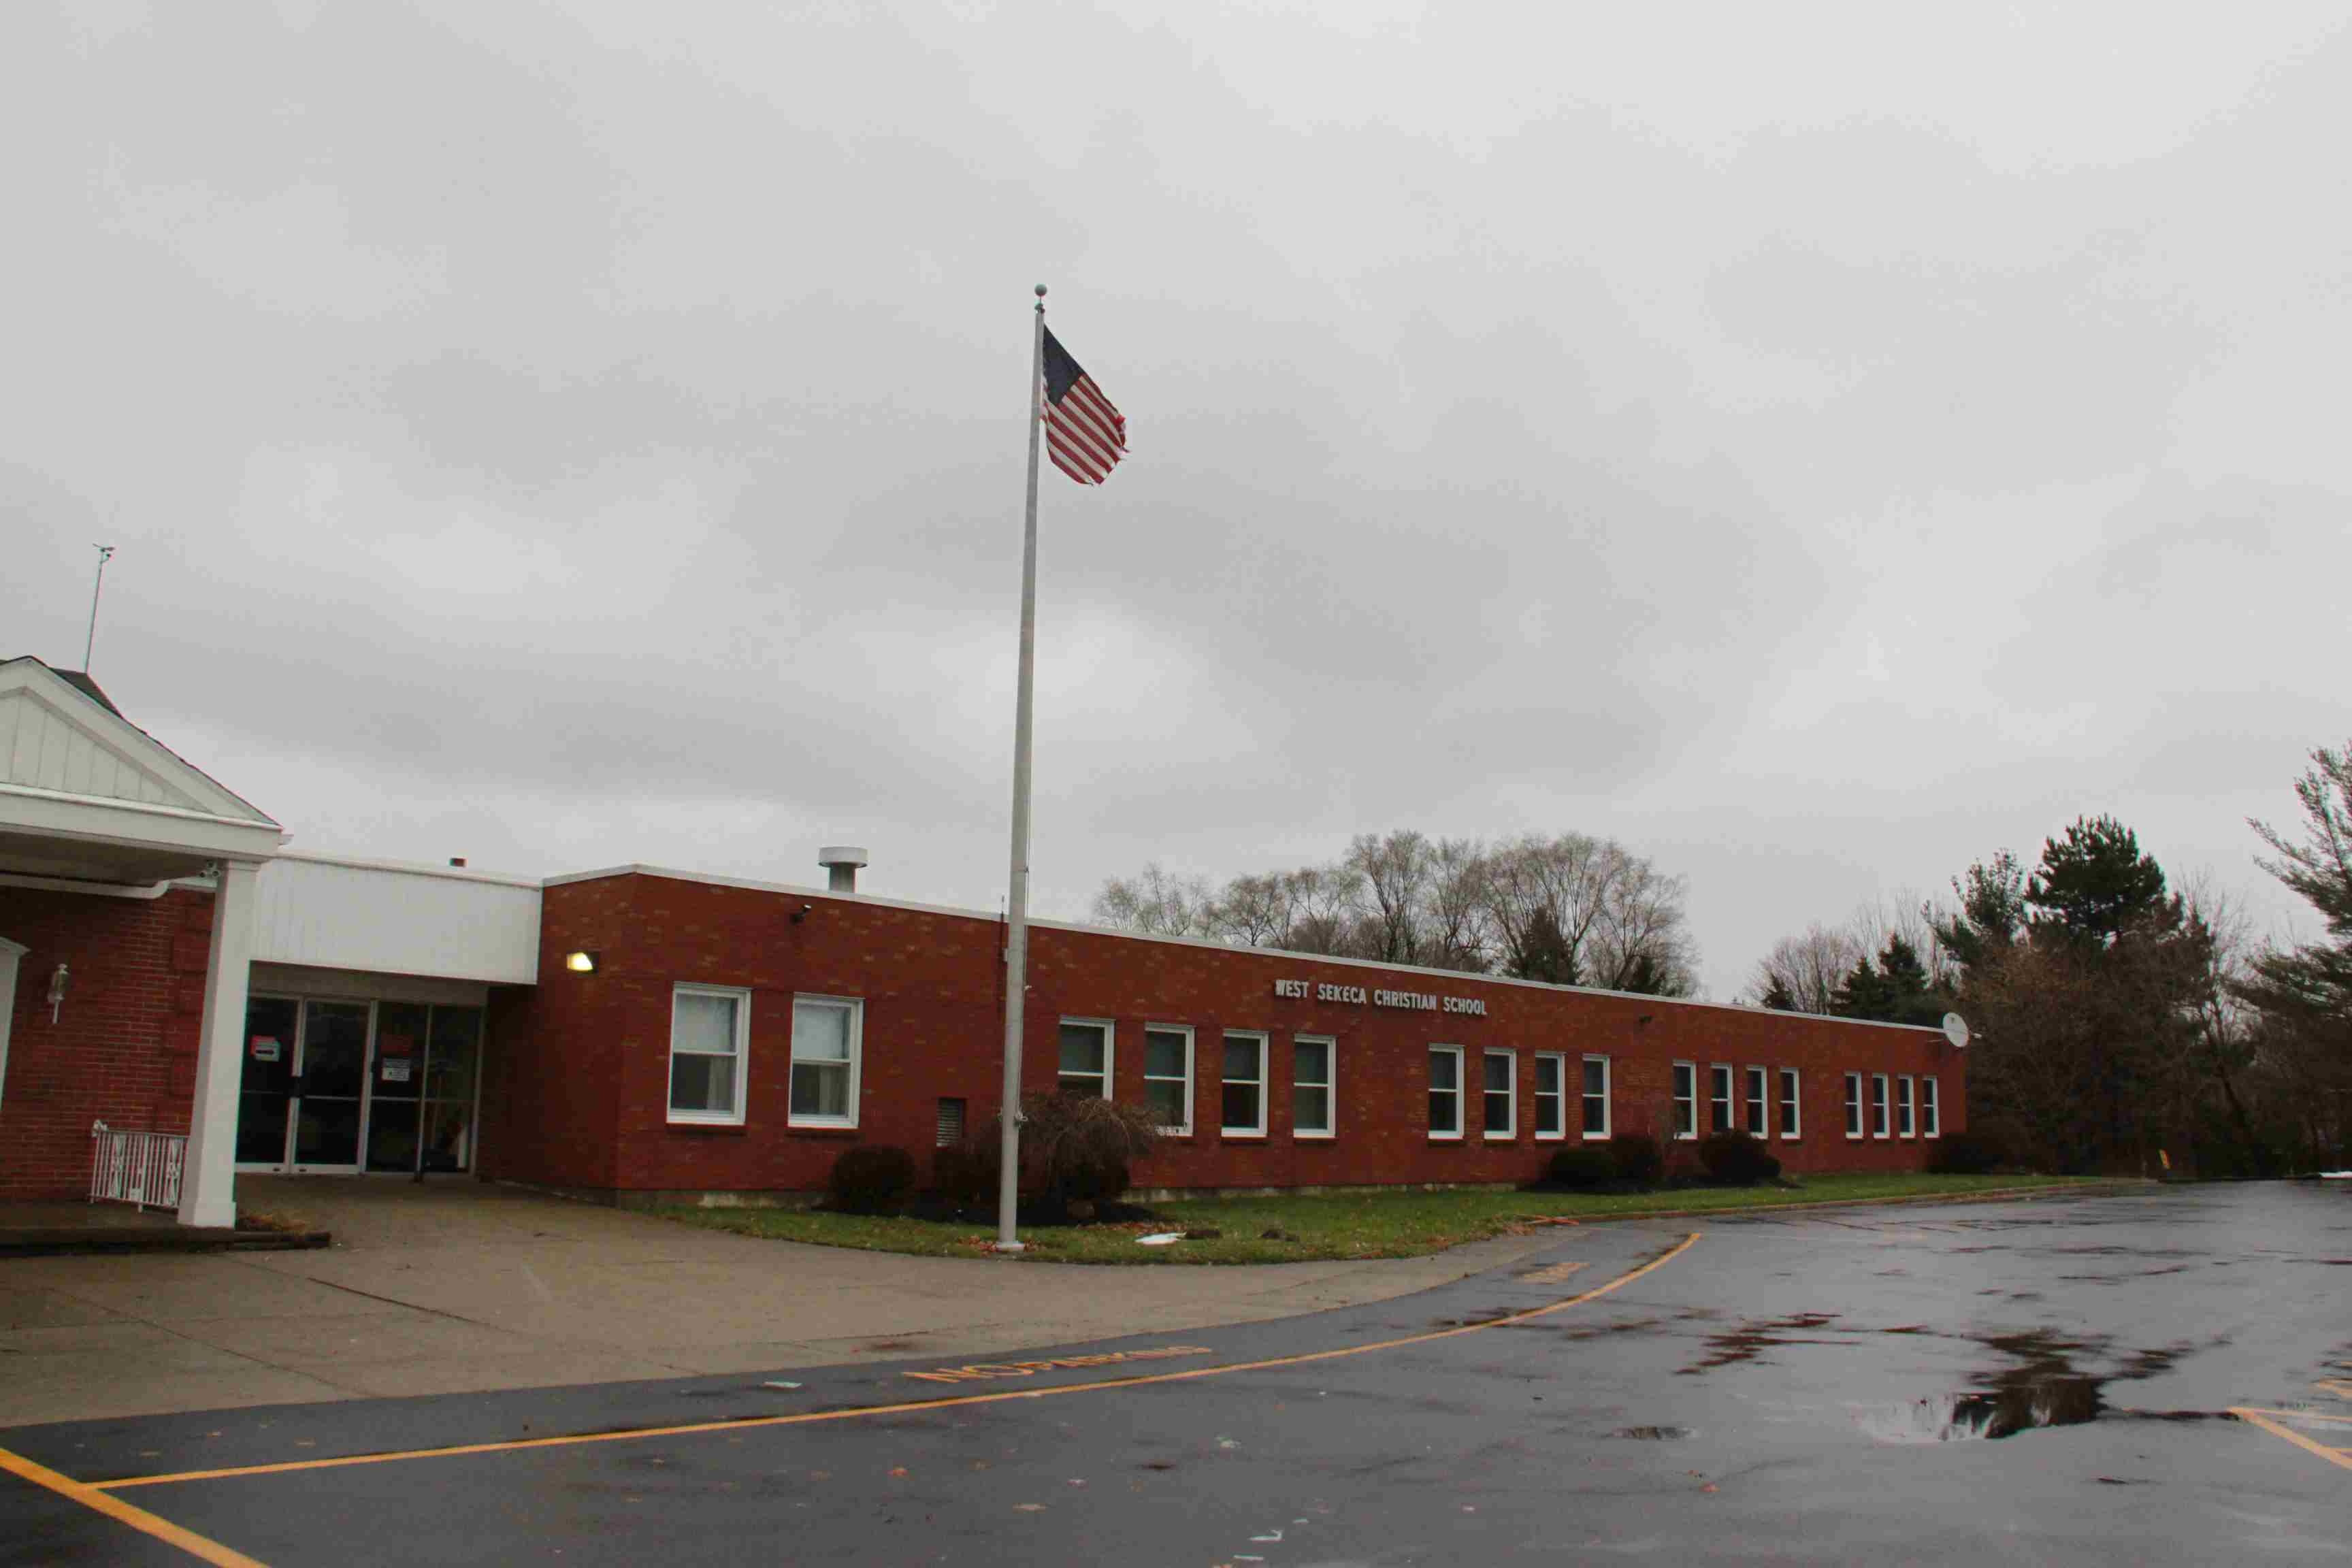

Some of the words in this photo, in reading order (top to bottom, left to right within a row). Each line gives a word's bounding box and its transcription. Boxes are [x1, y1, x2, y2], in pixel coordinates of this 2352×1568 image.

[1275, 979, 1309, 998] WEST
[1373, 989, 1438, 1011] CHRISTIAN
[1442, 996, 1488, 1016] SCHOOL
